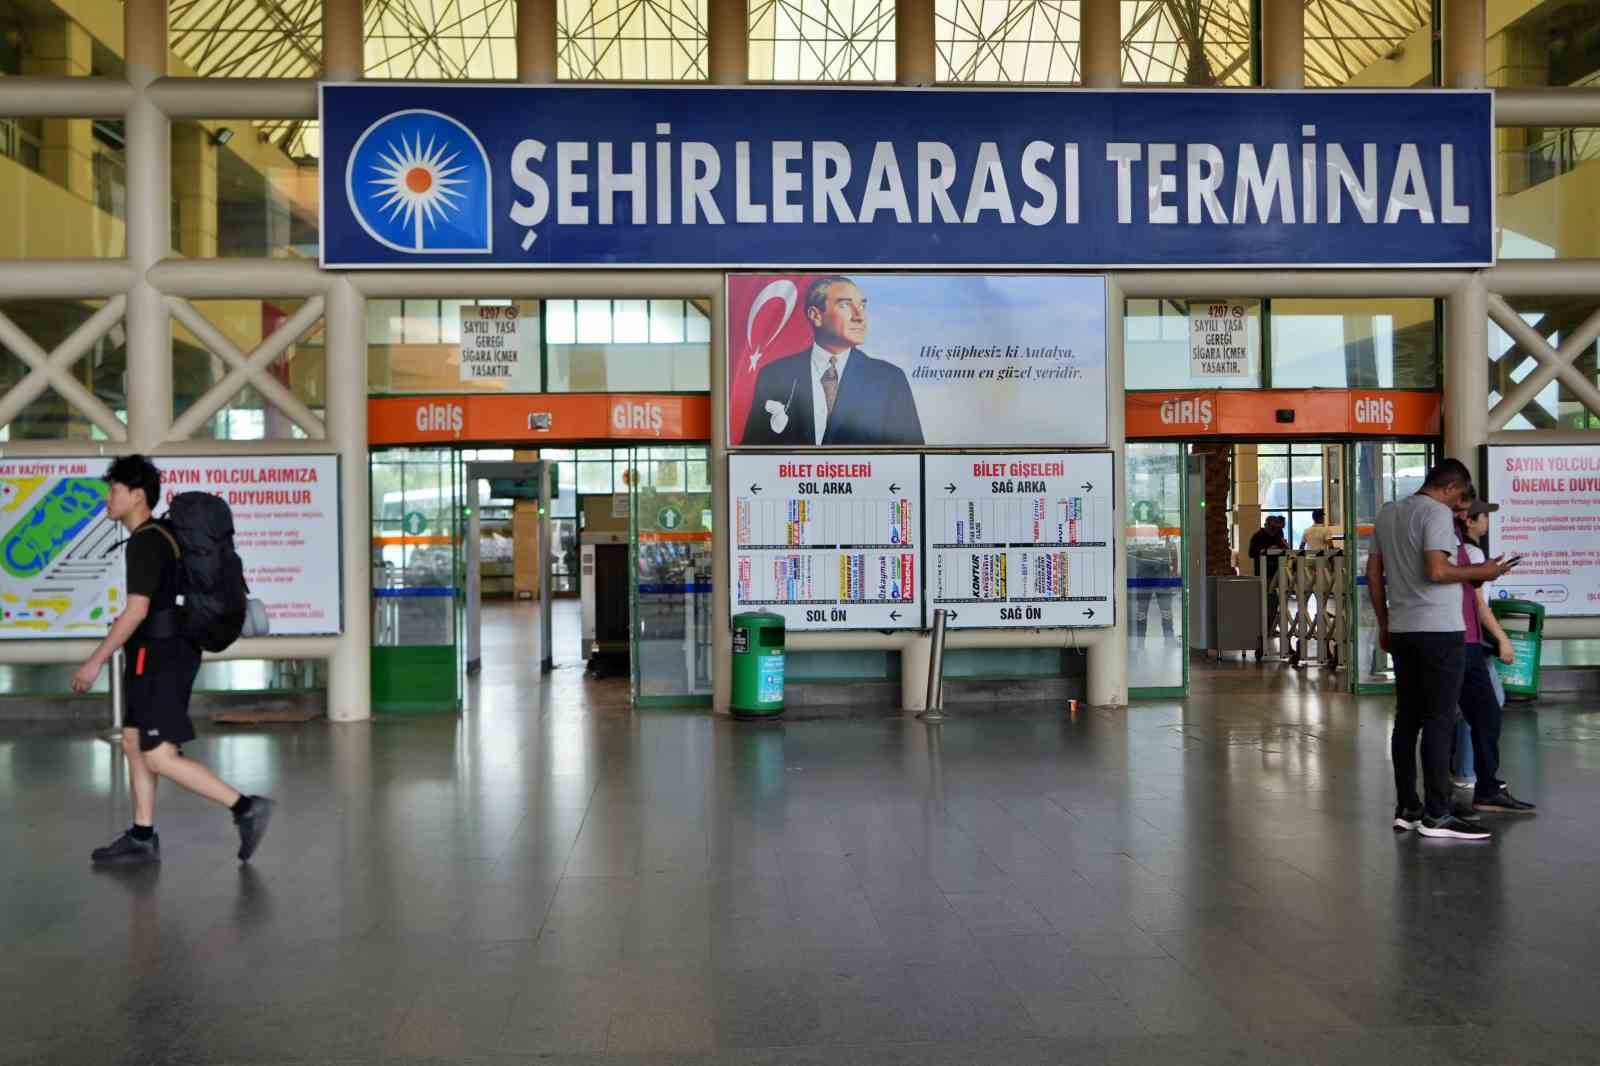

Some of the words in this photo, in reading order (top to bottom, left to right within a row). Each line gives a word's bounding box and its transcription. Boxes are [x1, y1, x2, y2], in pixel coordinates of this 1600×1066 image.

[509, 121, 1080, 251] ŞEHİRLERARASI
[1107, 124, 1470, 224] TERMİNAL
[1208, 305, 1228, 318] 4207
[464, 321, 489, 334] SAYILI
[496, 321, 516, 334] YASA
[1195, 319, 1219, 332] SAYILI
[1224, 319, 1244, 332] YASA
[920, 345, 943, 360] Hiç
[945, 345, 1001, 360] şüphesiz
[1005, 345, 1019, 358] ki
[979, 368, 995, 378] en
[997, 365, 1033, 381] güzel
[416, 402, 464, 437] GİRİŞ
[613, 401, 663, 436] GİRİŞ
[1161, 398, 1213, 431] GİRİŞ
[1355, 397, 1394, 431] GİRİŞ
[779, 460, 813, 478] BİLET
[816, 460, 872, 480] GİŞELERİ
[973, 459, 1007, 478] BİLET
[1010, 459, 1064, 479] GİŞELERİ
[1506, 457, 1544, 472] SAYIN
[160, 468, 200, 484] SAYIN
[206, 467, 318, 484] YOLCULARIMIZA
[1512, 475, 1566, 492] ÖNEMLE
[798, 482, 819, 495] SOL
[822, 482, 853, 495] ARKA
[991, 479, 1014, 494] SAĞ
[1017, 480, 1047, 493] ARKA
[229, 490, 312, 505] DUYURULUR
[971, 554, 981, 598] KONTUR
[806, 609, 828, 622] SOL
[831, 607, 847, 622] ÖN
[1000, 605, 1022, 620] SAĞ
[1025, 605, 1042, 620] ÖN
